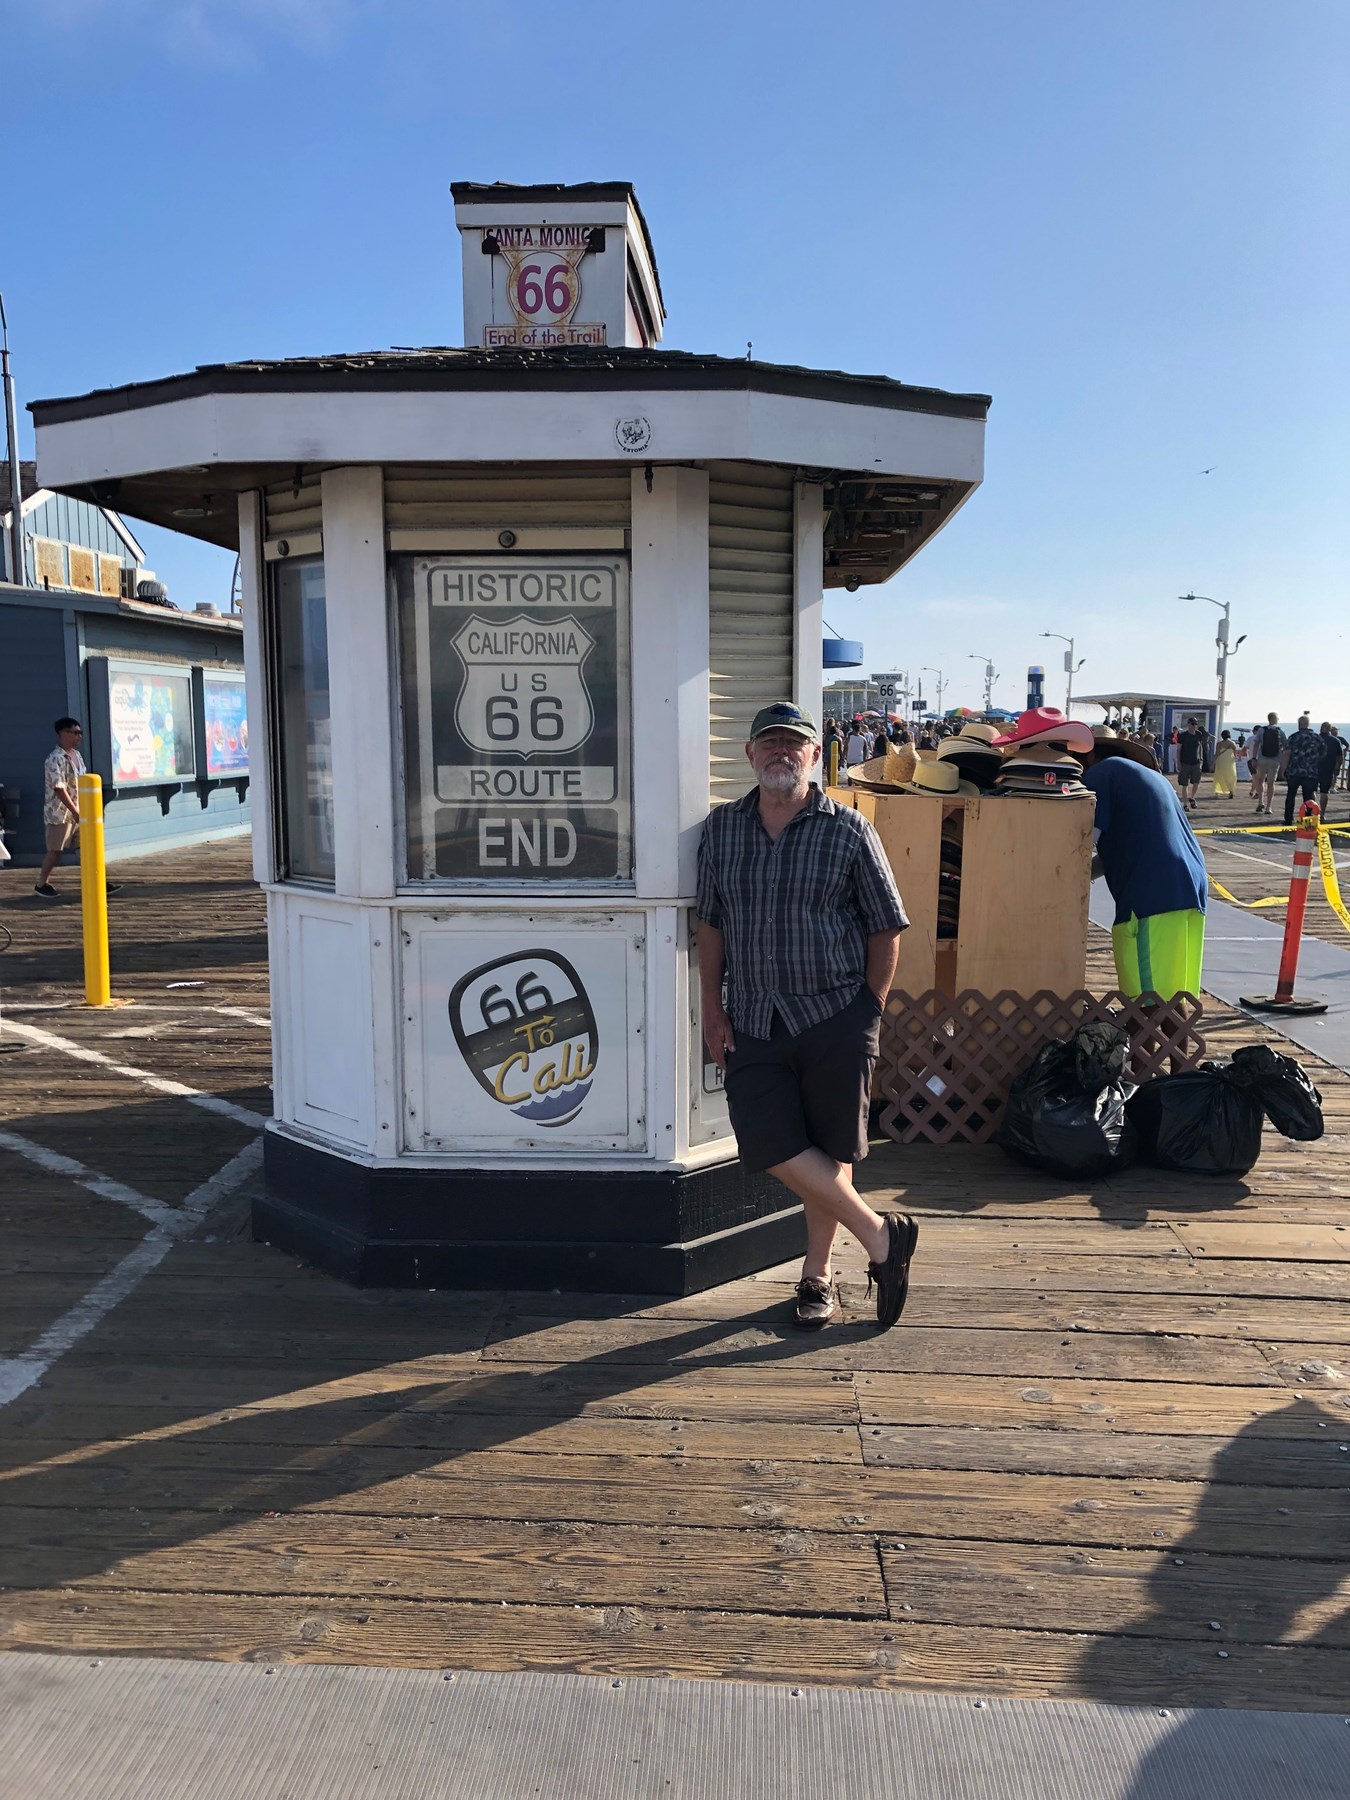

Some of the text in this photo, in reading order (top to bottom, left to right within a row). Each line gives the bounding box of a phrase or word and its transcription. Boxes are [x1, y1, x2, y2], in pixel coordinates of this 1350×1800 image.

[539, 227, 591, 247] MONIC
[517, 264, 572, 315] 66
[489, 328, 601, 345] End of the Trail
[443, 573, 602, 602] HISTORIC
[468, 631, 579, 655] CALIFORNIA
[501, 672, 548, 692] U S
[880, 684, 894, 697] 66
[485, 695, 564, 741] 66
[470, 769, 582, 797] ROUTE
[478, 818, 577, 867] END
[1320, 835, 1334, 877] CAUTION
[480, 971, 554, 1028] 66
[514, 1015, 556, 1052] To
[495, 1042, 593, 1105] Cali
